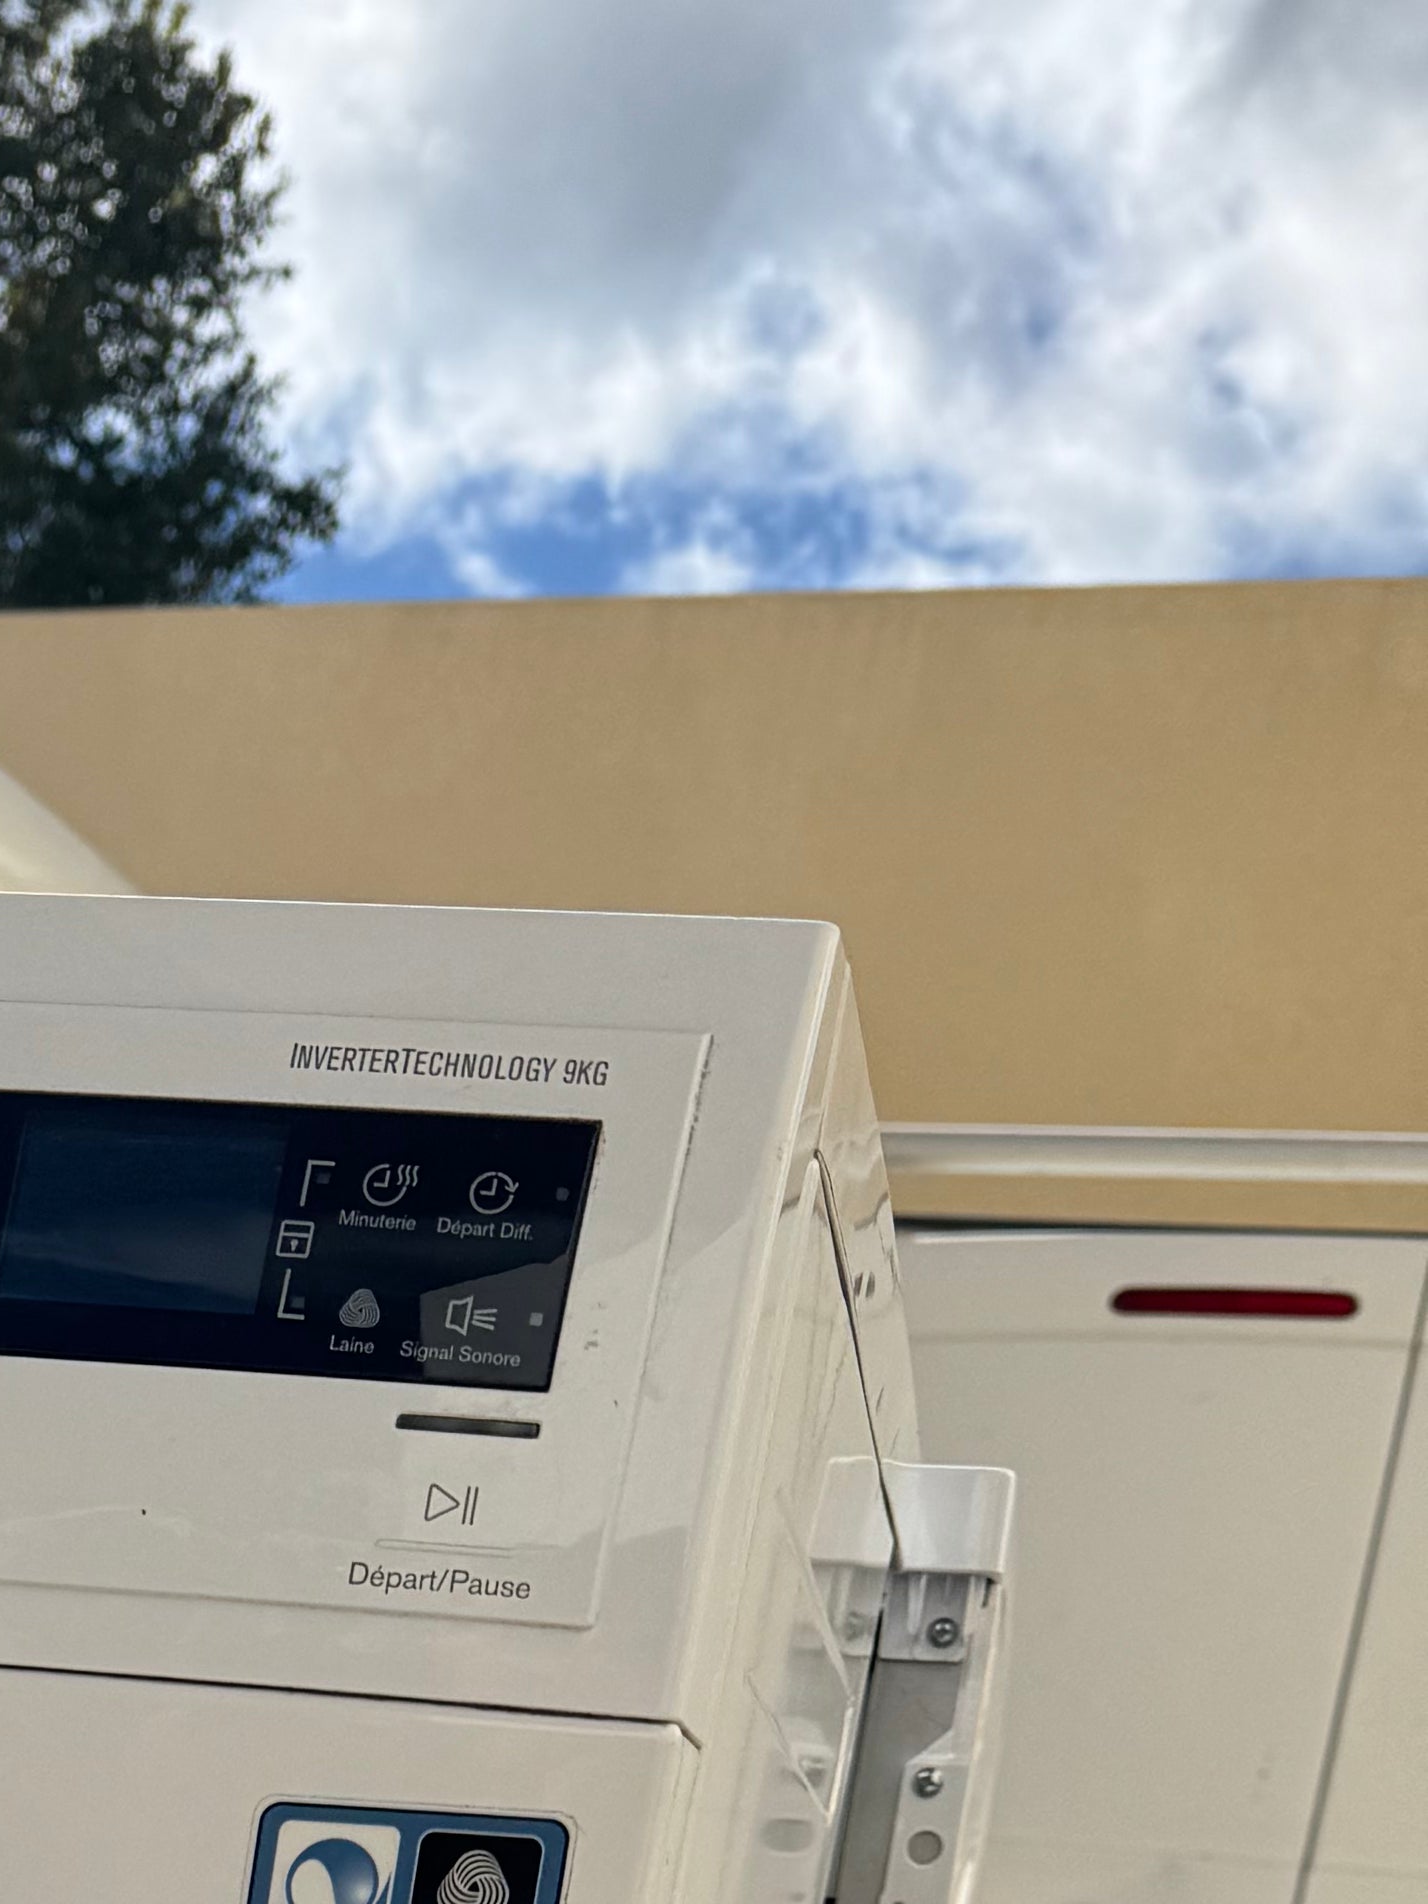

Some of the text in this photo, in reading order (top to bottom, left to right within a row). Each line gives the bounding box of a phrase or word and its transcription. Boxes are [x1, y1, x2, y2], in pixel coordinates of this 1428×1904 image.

[290, 1043, 610, 1086] INVERTERTECHNOLOGY 9KG
[338, 1209, 417, 1231] Minuterie
[437, 1216, 534, 1241] Départ Diff.
[329, 1335, 375, 1354] Laine
[400, 1340, 521, 1367] Signal Sonore
[348, 1561, 531, 1599] Départ/Pause
